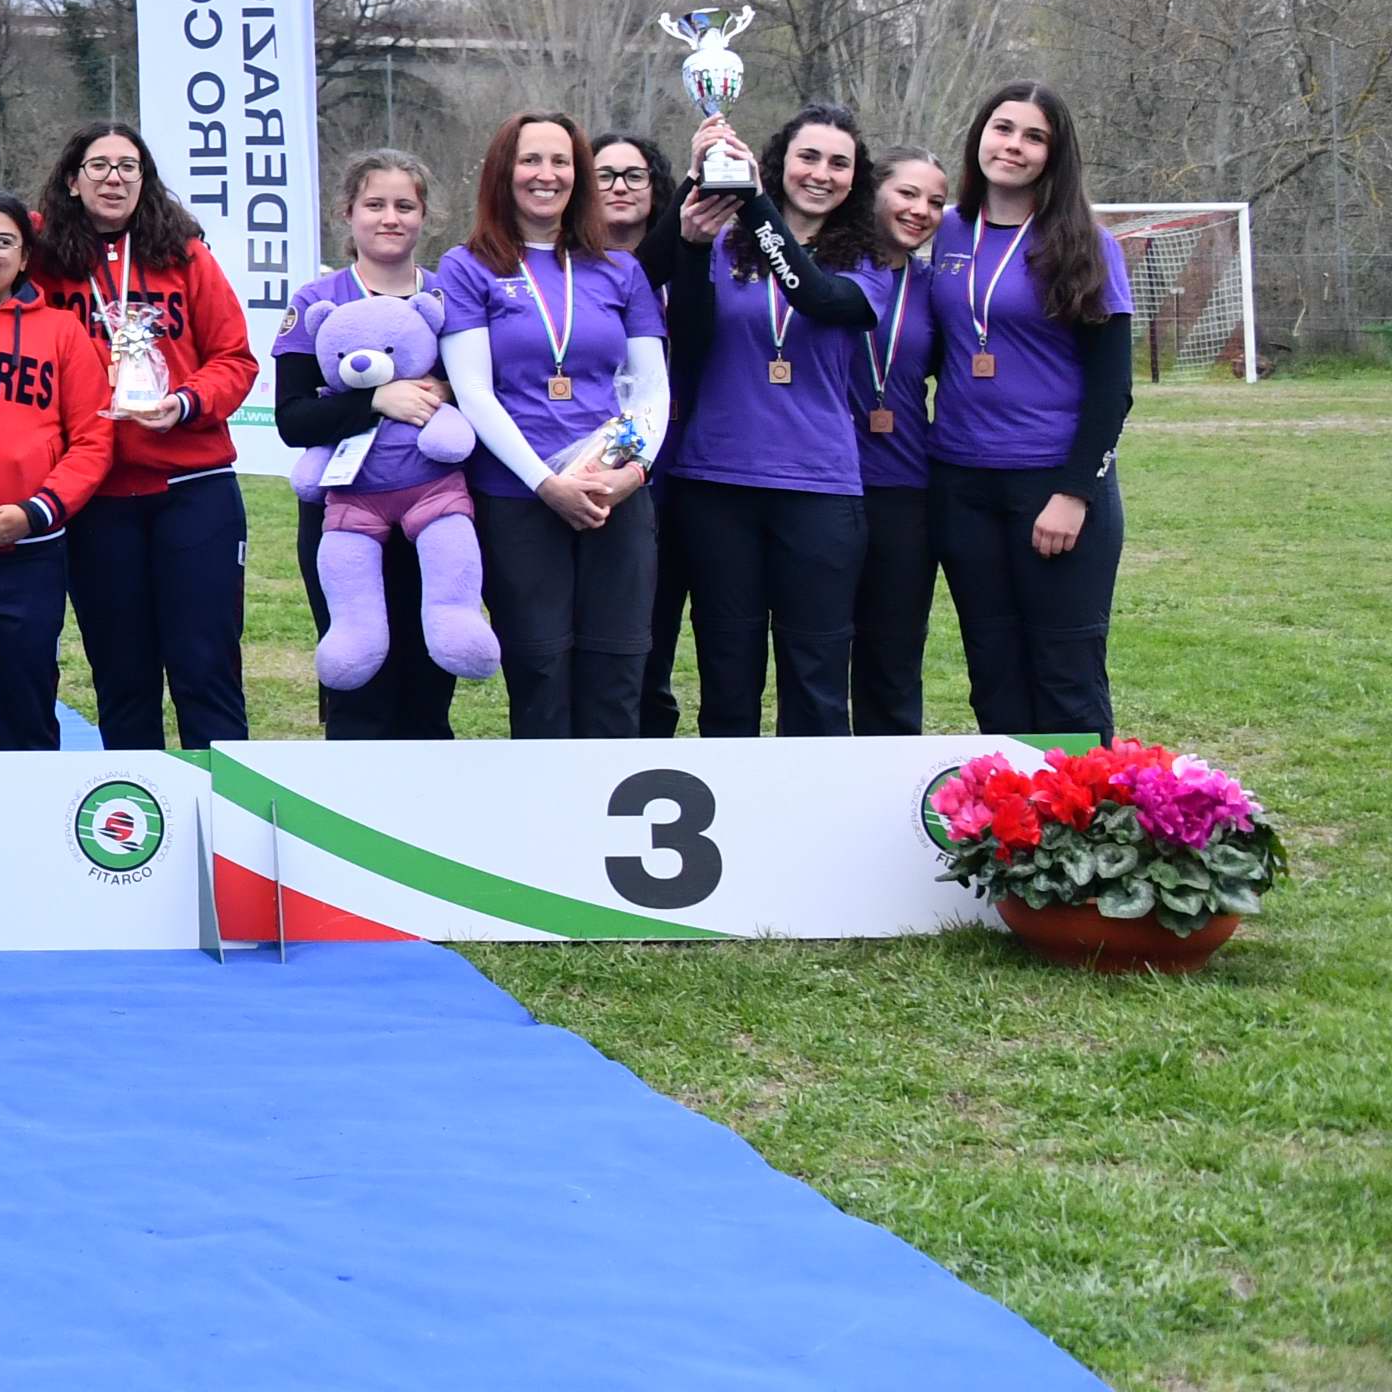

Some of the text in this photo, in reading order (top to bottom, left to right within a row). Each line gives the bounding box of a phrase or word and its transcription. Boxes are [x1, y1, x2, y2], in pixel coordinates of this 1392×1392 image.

[754, 221, 800, 289] TRENTINO
[604, 768, 723, 908] 3
[88, 867, 153, 885] FITARCO
